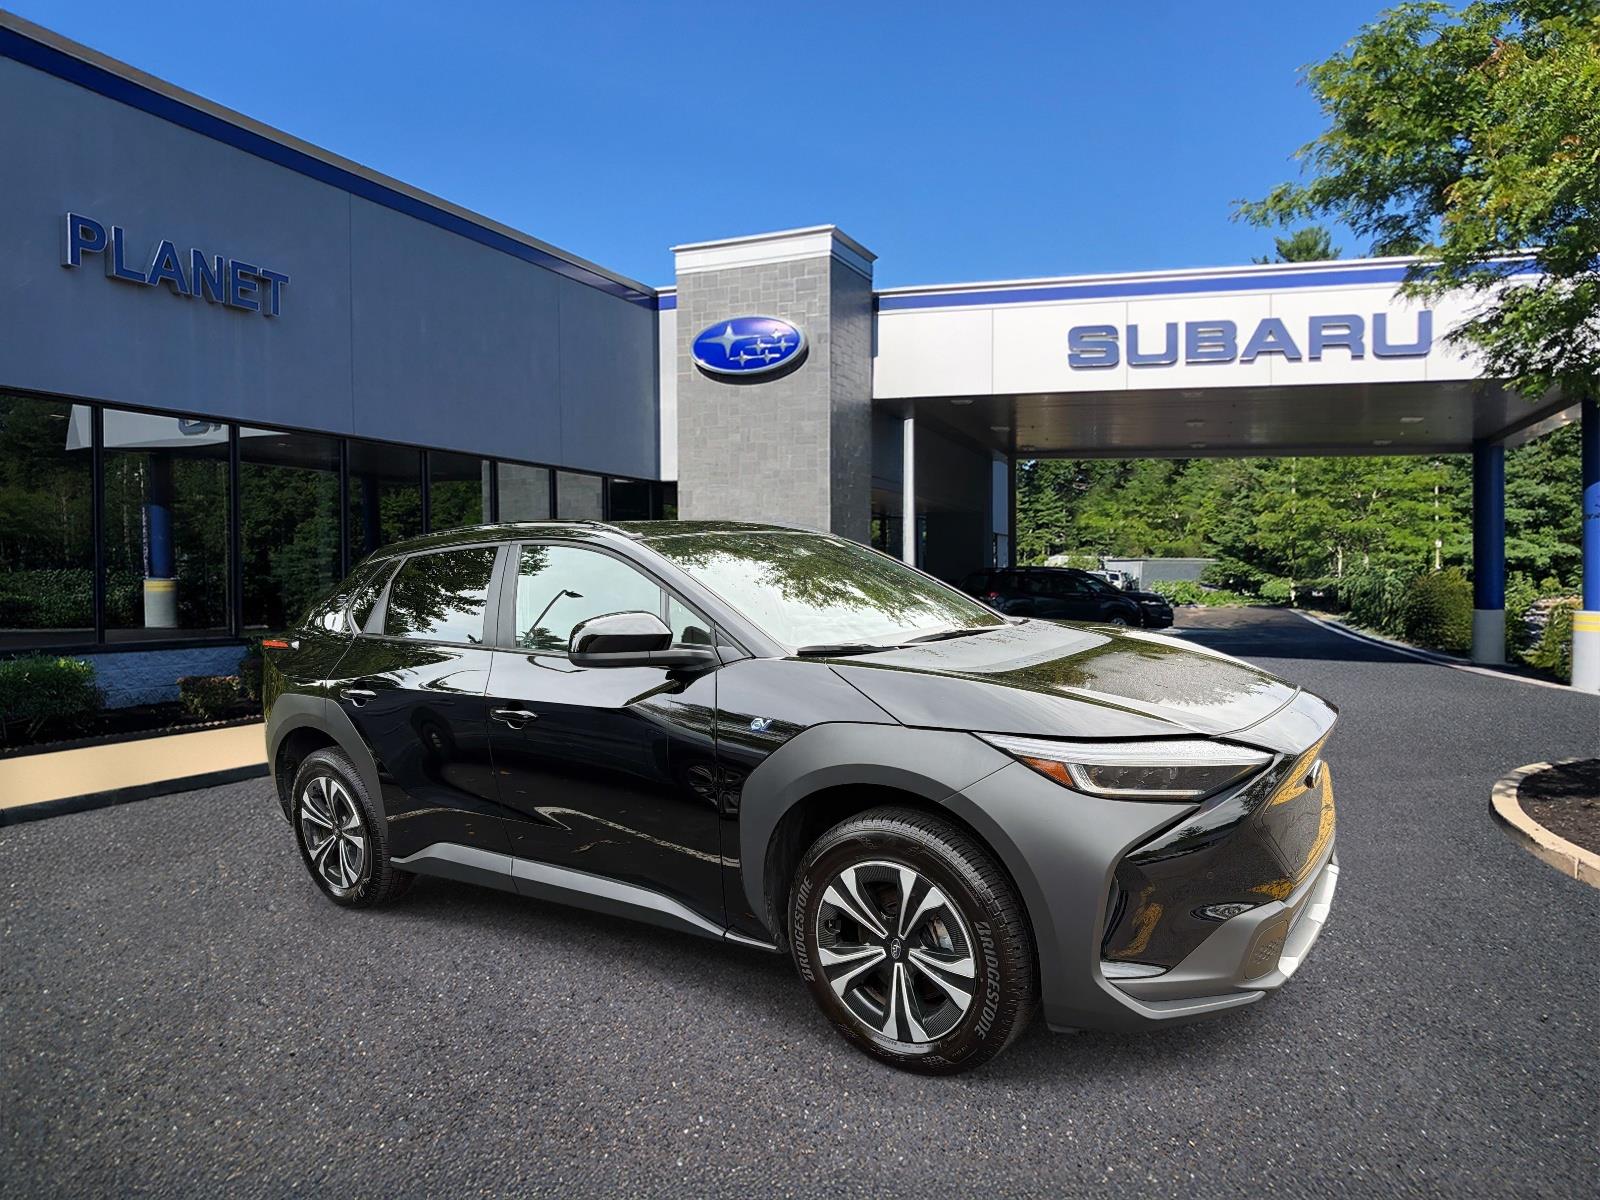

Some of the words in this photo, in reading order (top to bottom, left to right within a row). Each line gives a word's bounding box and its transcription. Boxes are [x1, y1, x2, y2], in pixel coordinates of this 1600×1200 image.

[62, 212, 289, 316] PLANET
[1067, 309, 1433, 368] SUBARU
[795, 875, 816, 983] BRIDGESTONE
[974, 921, 1000, 1040] BRIDGESTONE
